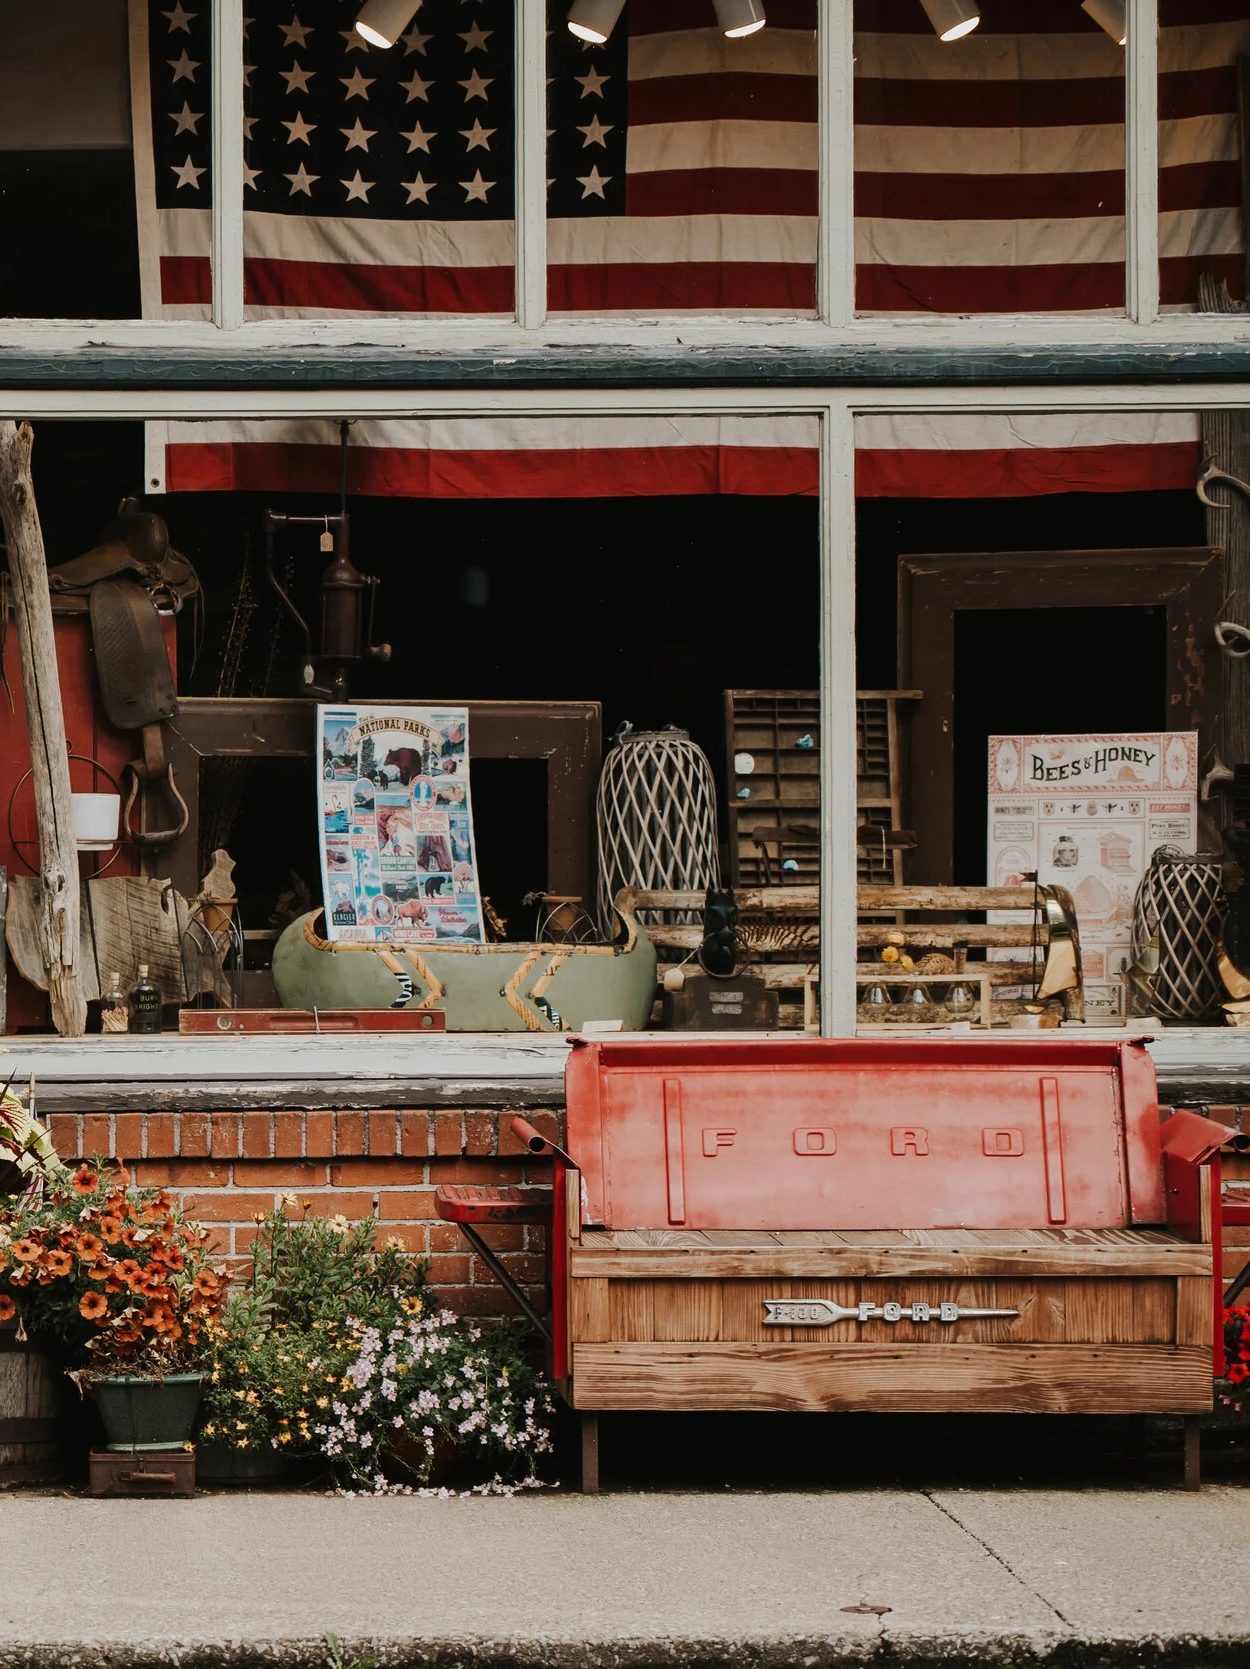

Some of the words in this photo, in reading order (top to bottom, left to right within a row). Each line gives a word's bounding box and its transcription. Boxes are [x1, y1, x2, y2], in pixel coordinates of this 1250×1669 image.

[358, 719, 401, 737] NATIONAL
[403, 720, 431, 739] PARKS
[1030, 753, 1082, 782] BEES
[1083, 756, 1094, 770] &
[1093, 746, 1156, 774] HONEY
[333, 913, 356, 922] GLACIER
[701, 1127, 1024, 1157] FORD
[857, 1302, 960, 1322] FORD
